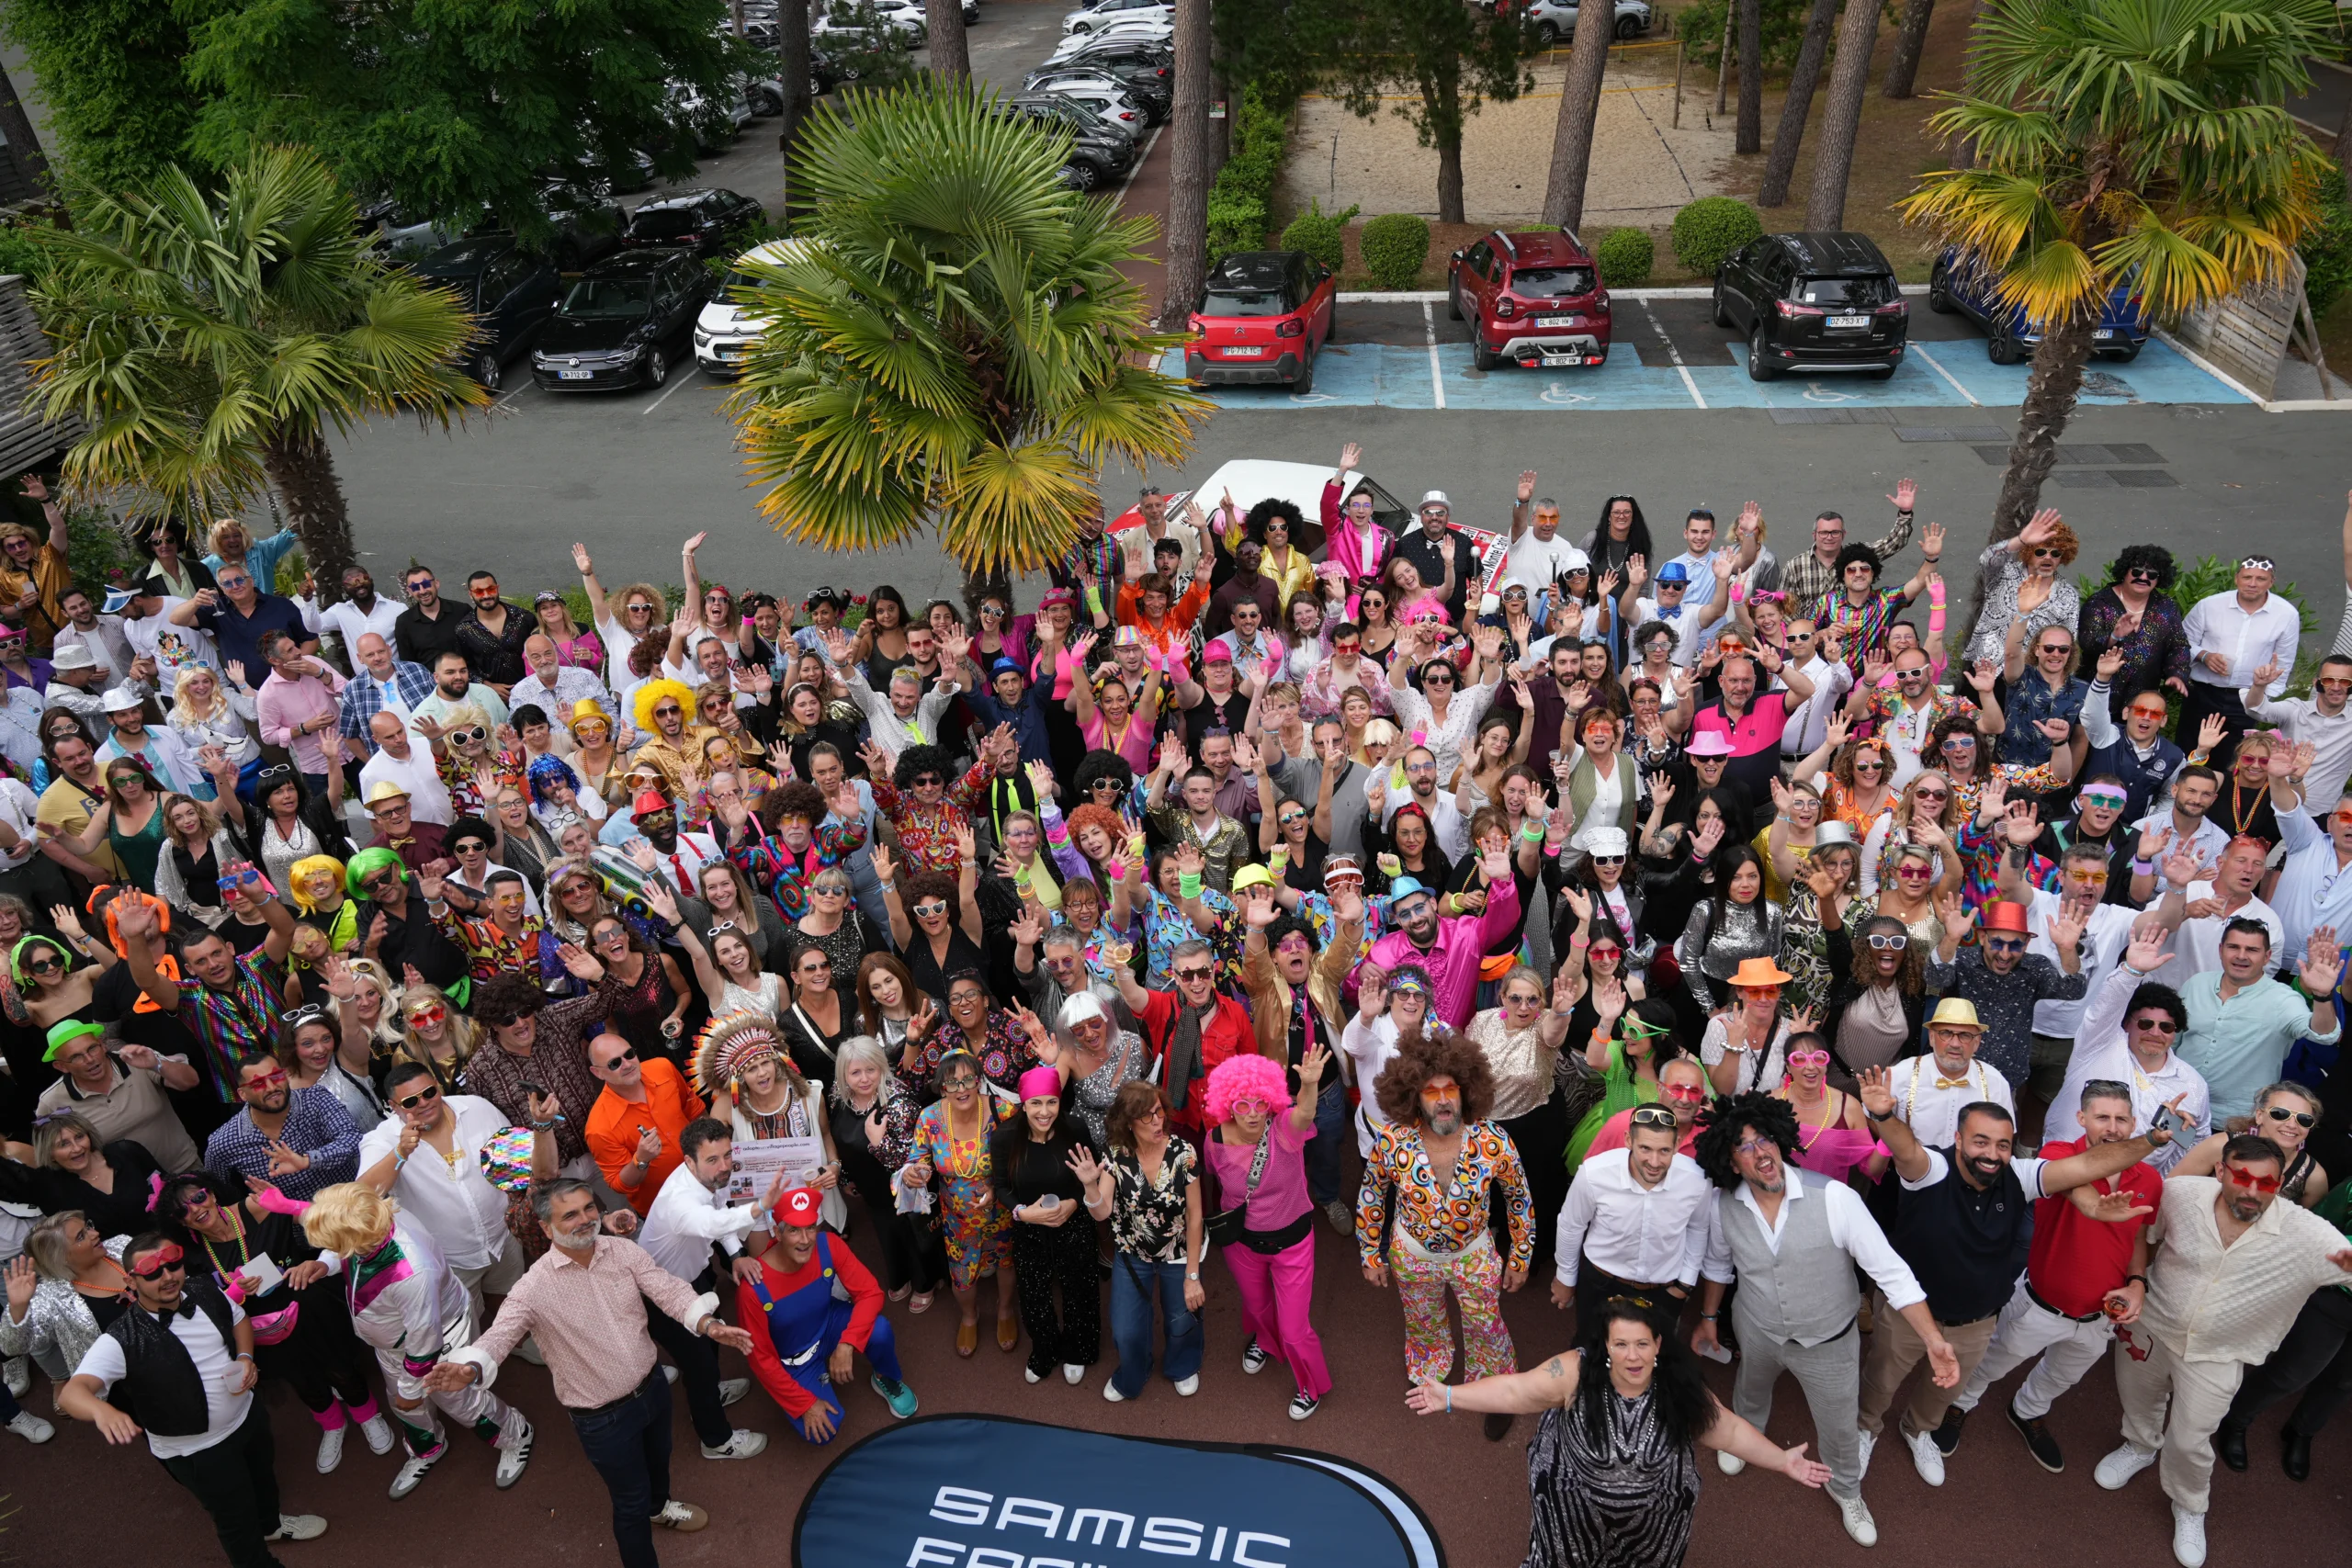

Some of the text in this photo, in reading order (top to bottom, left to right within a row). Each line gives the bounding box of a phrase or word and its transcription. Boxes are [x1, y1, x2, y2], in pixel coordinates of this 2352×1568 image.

[1538, 317, 1569, 326] GL-802-HW
[1830, 317, 1865, 325] DZ-753-XT
[1227, 346, 1258, 355] FG-712-YC
[1545, 356, 1577, 366] GL-802-HW
[794, 1195, 808, 1206] M
[929, 1486, 1291, 1568] SAMSIC
